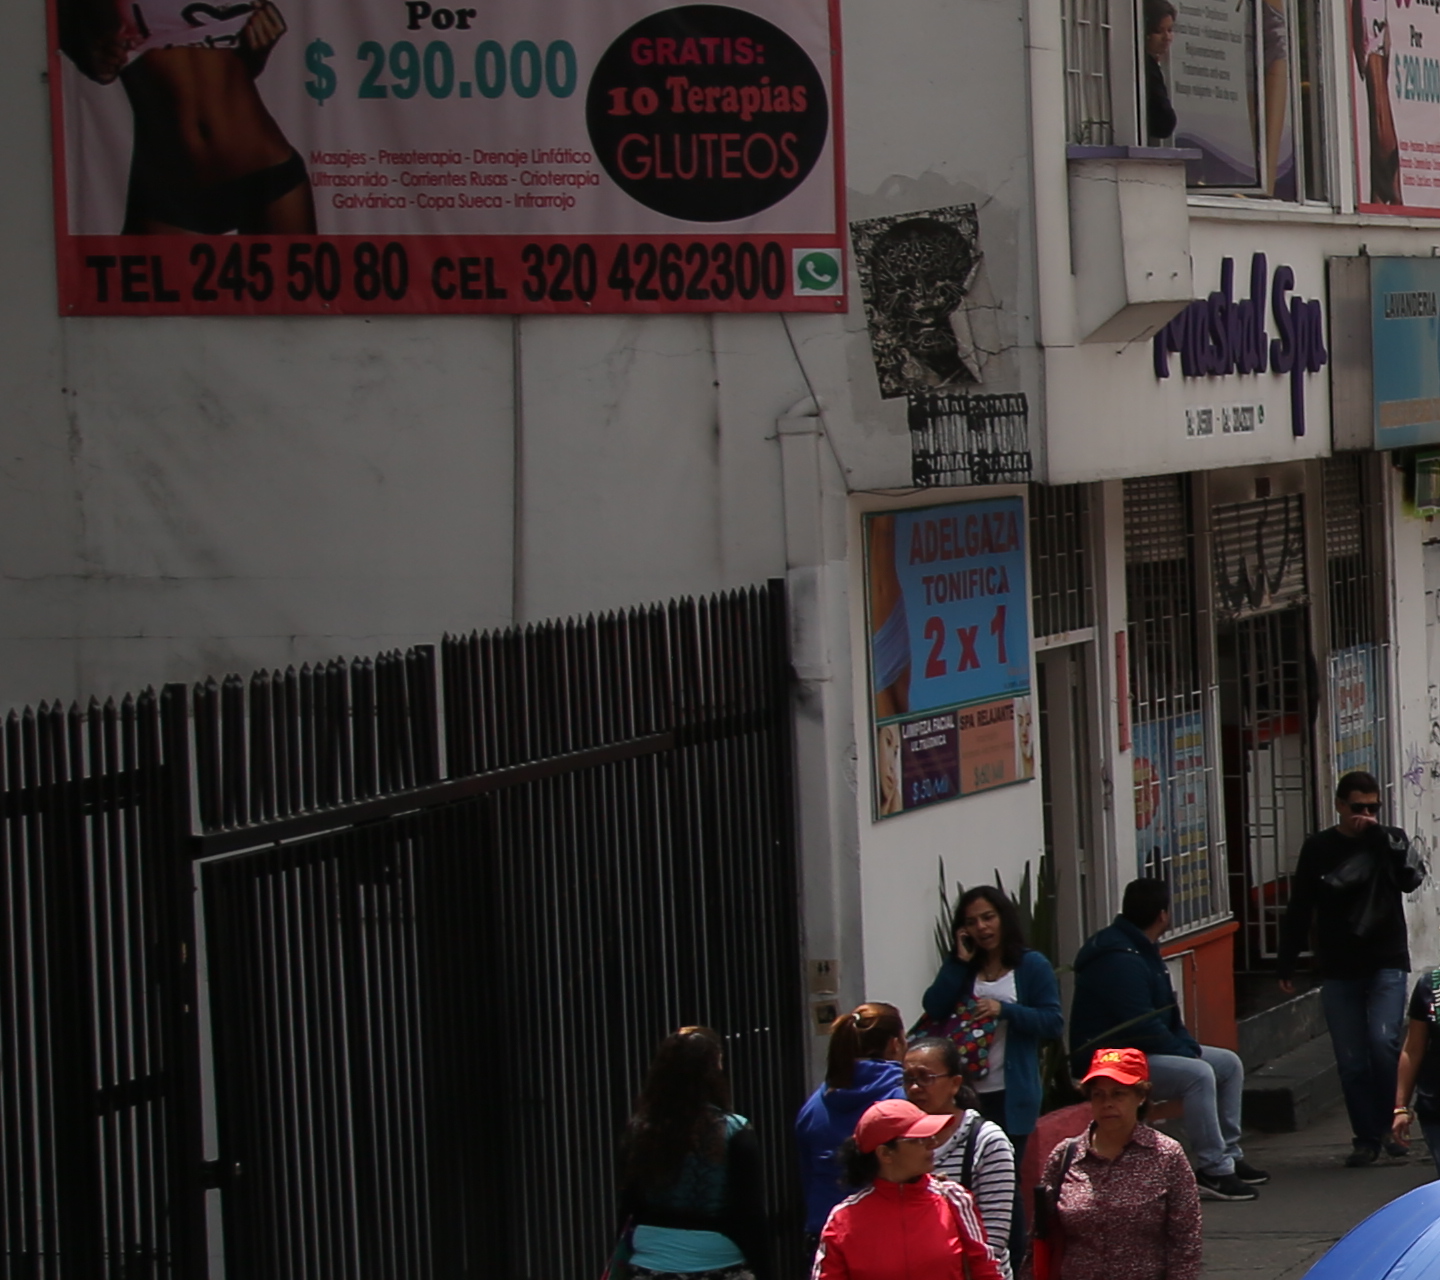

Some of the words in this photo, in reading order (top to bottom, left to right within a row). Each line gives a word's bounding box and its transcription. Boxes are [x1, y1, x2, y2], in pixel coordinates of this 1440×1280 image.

[404, 0, 477, 31] Por
[304, 38, 337, 106] $
[357, 39, 579, 101] 290.000
[630, 37, 766, 66] GRATIS:
[606, 86, 659, 116] 10
[668, 75, 808, 122] Terapias
[310, 149, 367, 167] Masajes
[378, 149, 462, 167] Presoterapia
[472, 148, 527, 167] Drenaje
[617, 132, 799, 180] GLUTEOS
[310, 171, 389, 189] Ultrasonido
[400, 171, 466, 188] Corrientes
[469, 171, 508, 188] Rusas
[520, 170, 600, 189] Crioterapia
[417, 193, 454, 211] Copa
[457, 193, 507, 211] Sueca
[515, 192, 576, 211] Infrarrojo
[85, 255, 180, 303] TEL
[190, 243, 275, 301] 245
[287, 242, 343, 301] 50
[353, 241, 409, 300] 80
[431, 257, 507, 300] CEL
[521, 243, 598, 300] 320
[608, 240, 783, 301] 4262300
[1384, 292, 1437, 319] LAVANDERIA
[1269, 265, 1327, 437] Spa
[908, 510, 1021, 566] ADELGAZA
[921, 565, 1010, 606] TONIFICA
[923, 616, 948, 679] 2
[956, 625, 981, 673] x
[989, 604, 1008, 665] 1
